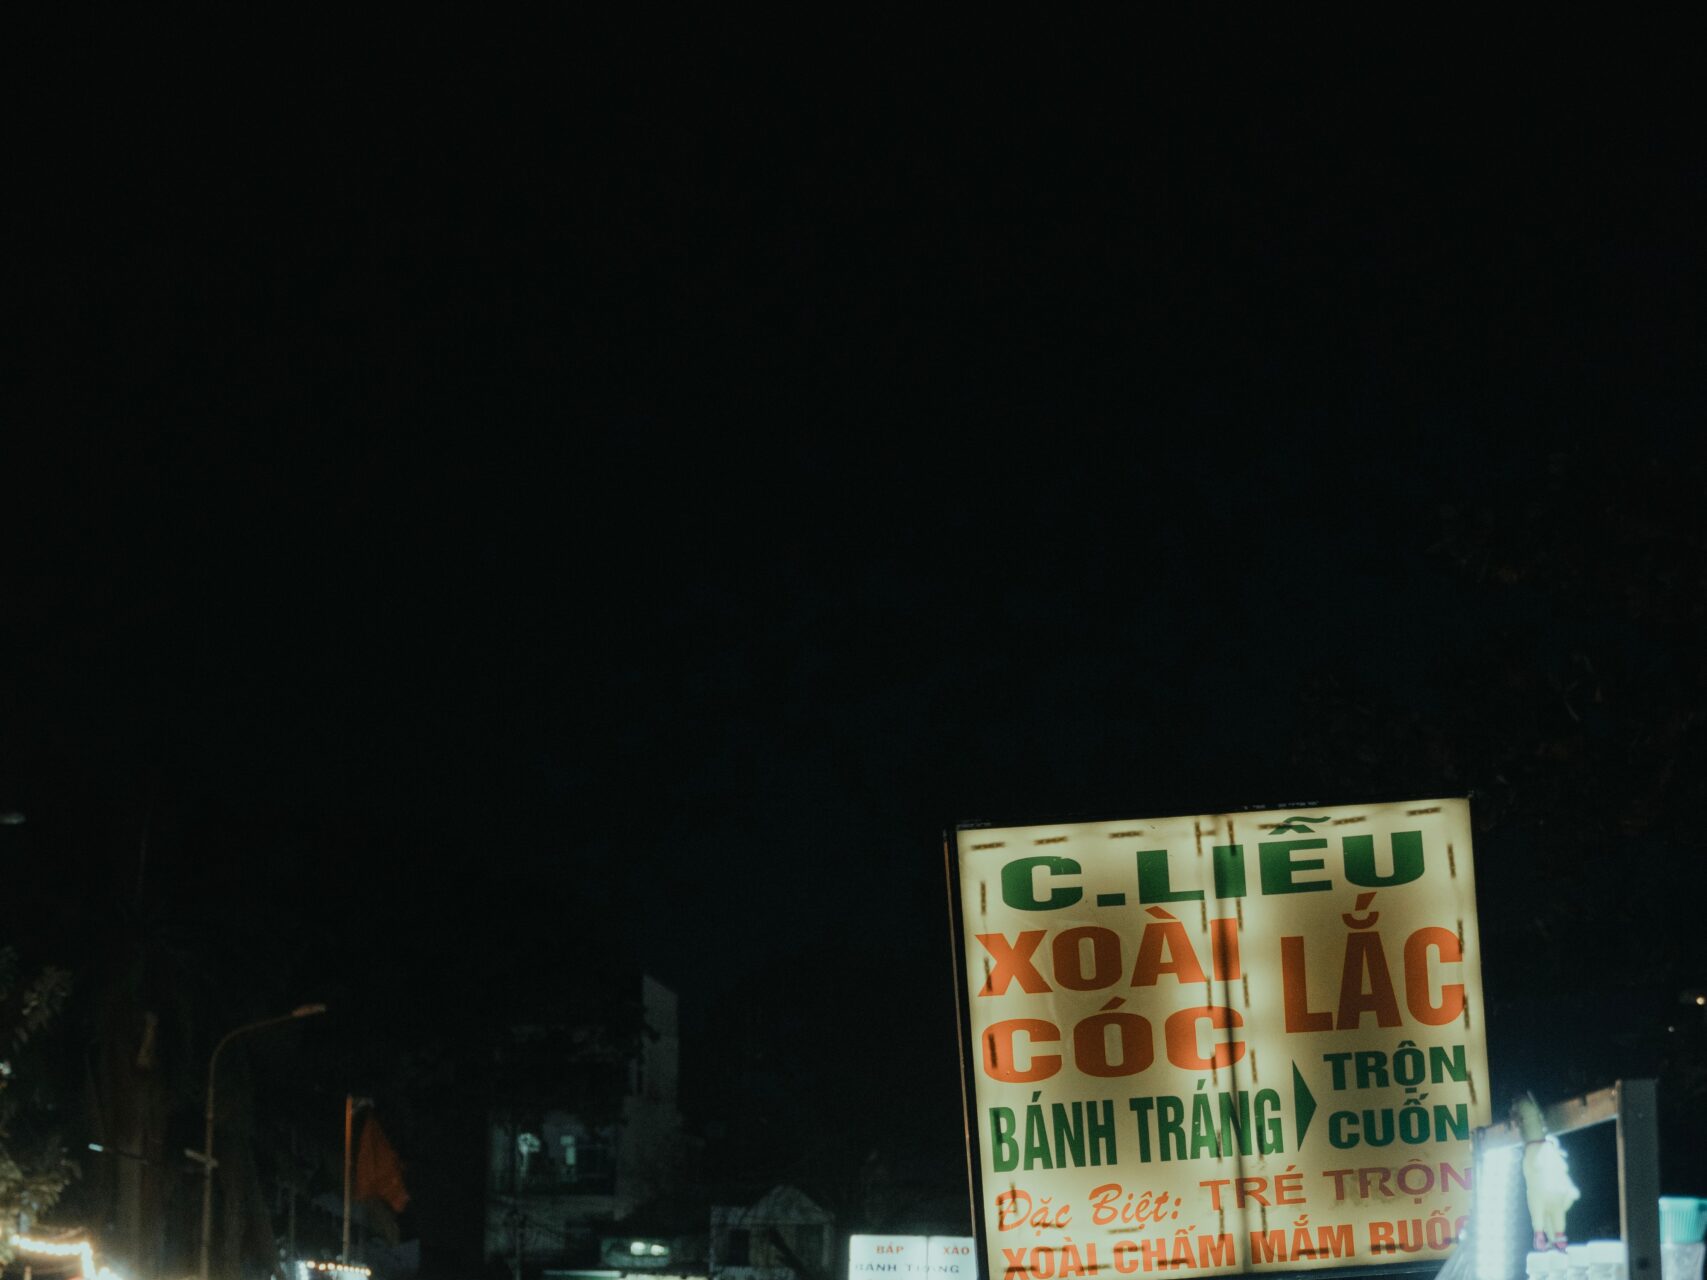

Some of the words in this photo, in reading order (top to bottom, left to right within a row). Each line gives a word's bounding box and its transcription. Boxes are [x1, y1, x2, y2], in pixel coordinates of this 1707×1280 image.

[1001, 816, 1425, 912] C.LIỄU
[975, 906, 1241, 997] XOÀI
[1281, 891, 1465, 1033] LẮC
[981, 997, 1246, 1083] CÓC
[1323, 1040, 1469, 1094] TRỘN
[988, 1091, 1118, 1173] BÁNH
[1130, 1079, 1285, 1164] TRÁNG
[1328, 1093, 1470, 1149] CUỐN
[995, 1189, 1072, 1236] Đặc
[1088, 1183, 1182, 1230] Biệt:
[1200, 1165, 1306, 1212] TRÉ
[1323, 1158, 1473, 1206] TRỘN
[1002, 1236, 1099, 1280] XOÀI
[1113, 1225, 1236, 1274] CHẤM
[1251, 1215, 1355, 1262] MẮM
